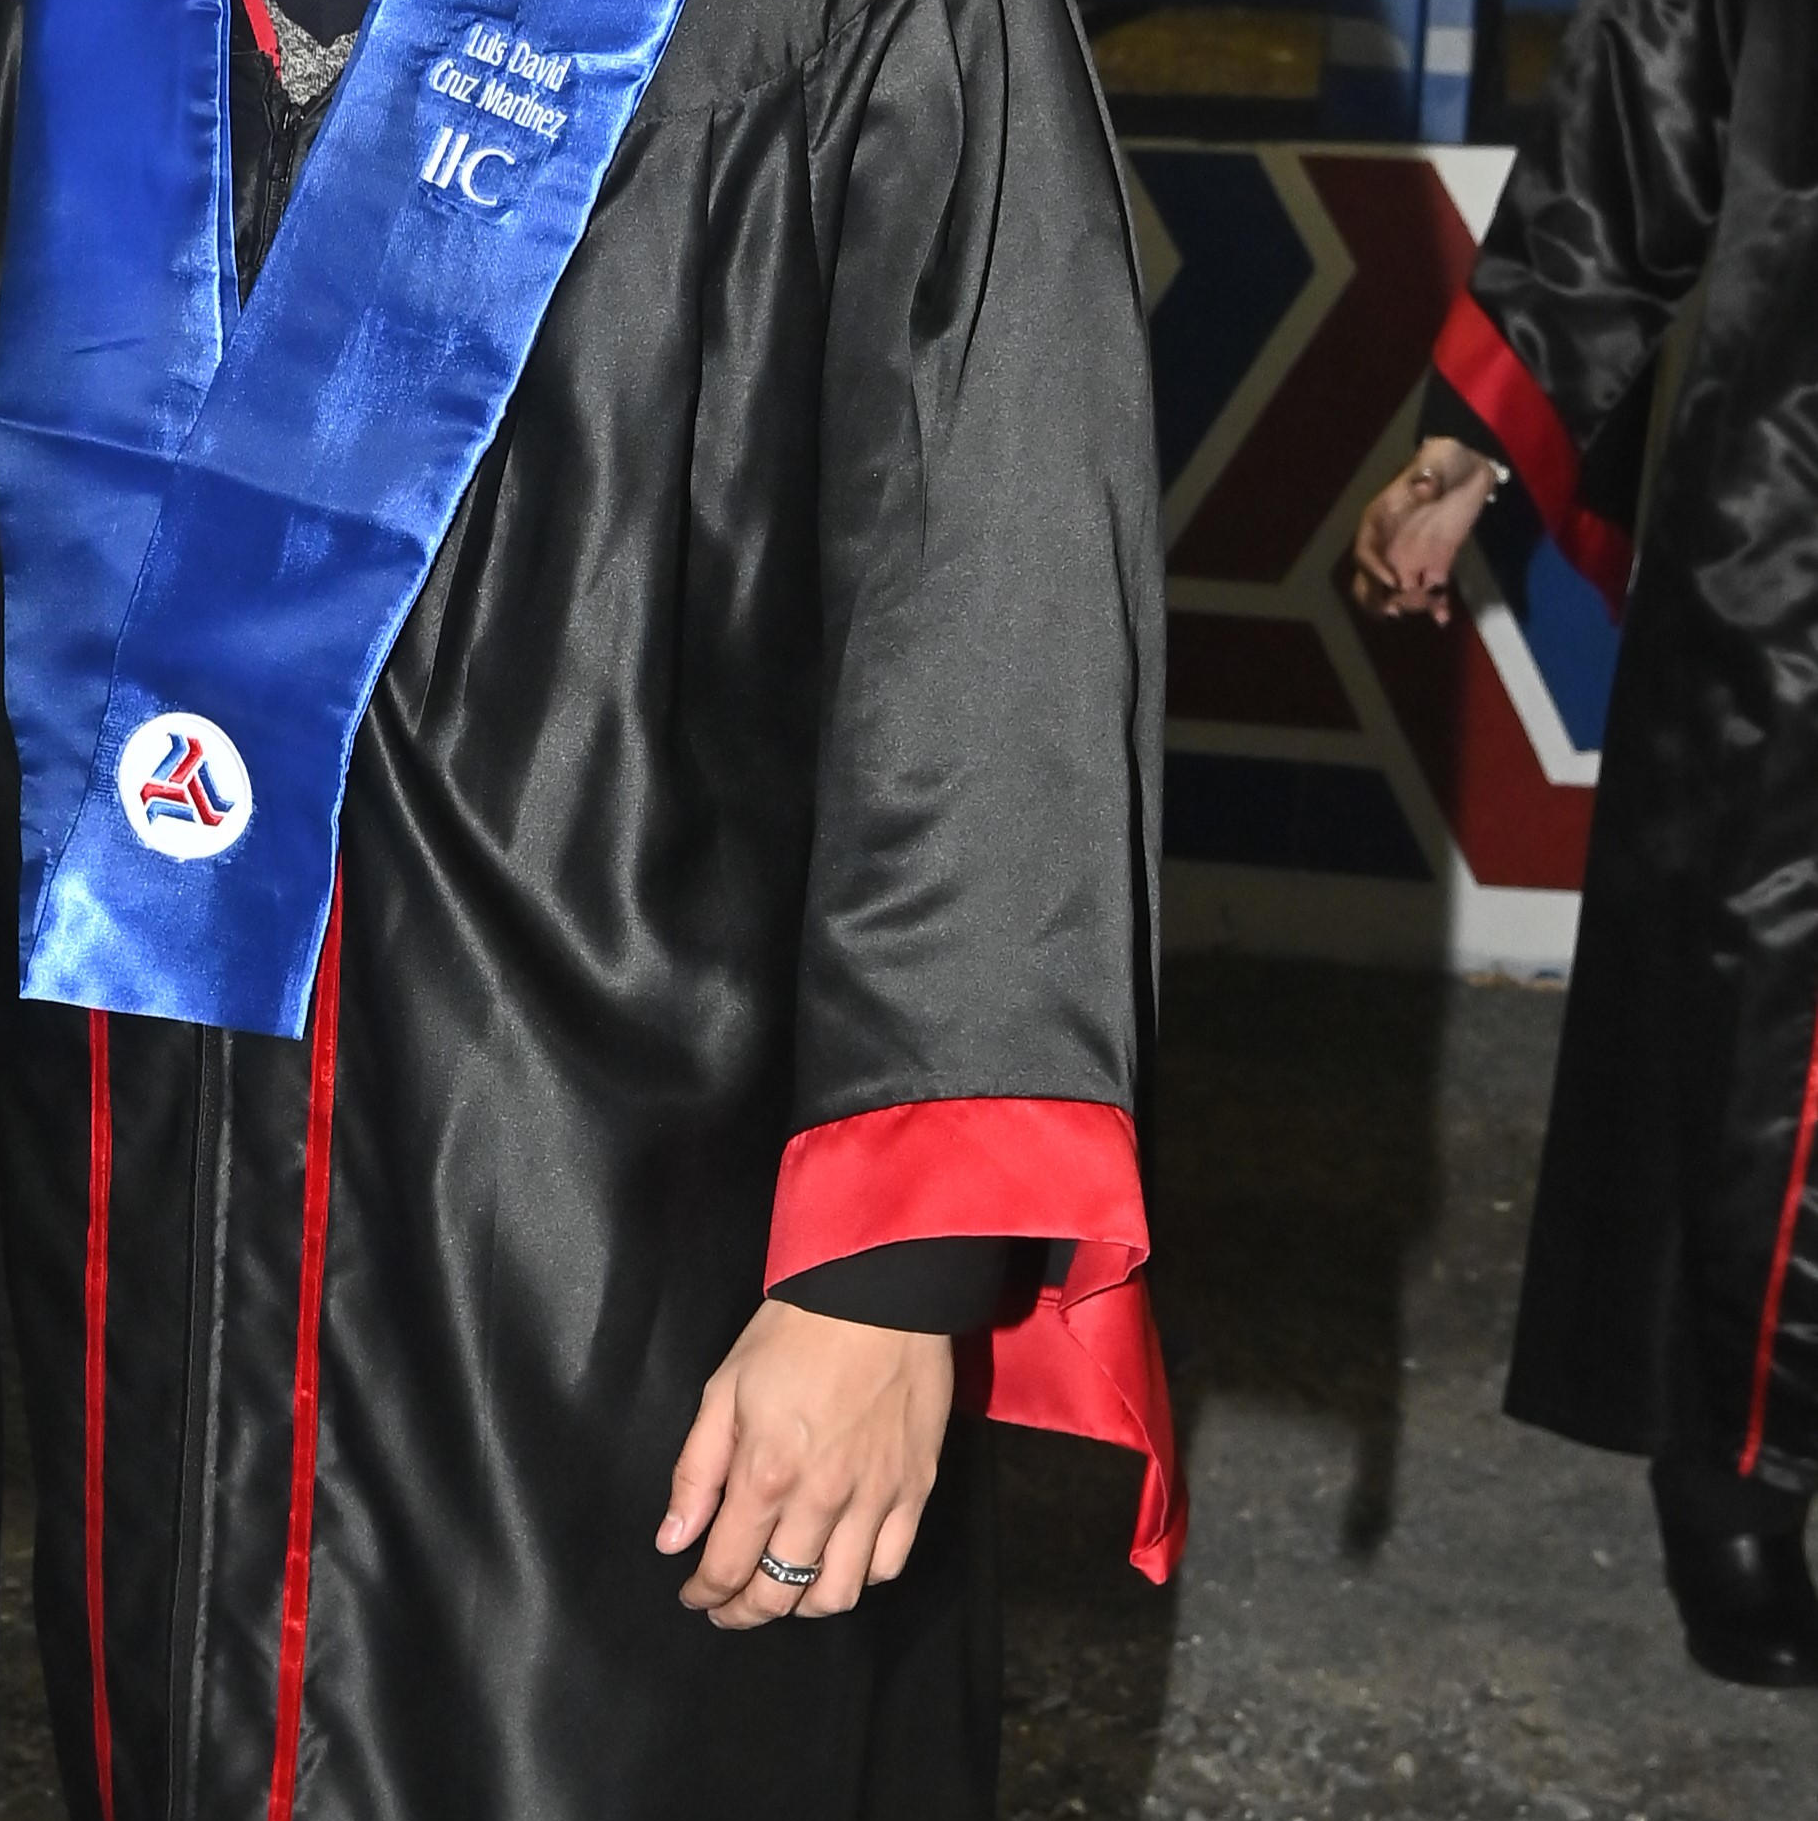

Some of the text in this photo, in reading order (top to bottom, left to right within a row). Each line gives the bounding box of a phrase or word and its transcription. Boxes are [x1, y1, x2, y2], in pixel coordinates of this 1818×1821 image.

[466, 25, 572, 92] Luis David
[431, 59, 568, 139] Cruz Martínez
[420, 128, 516, 206] IIC
